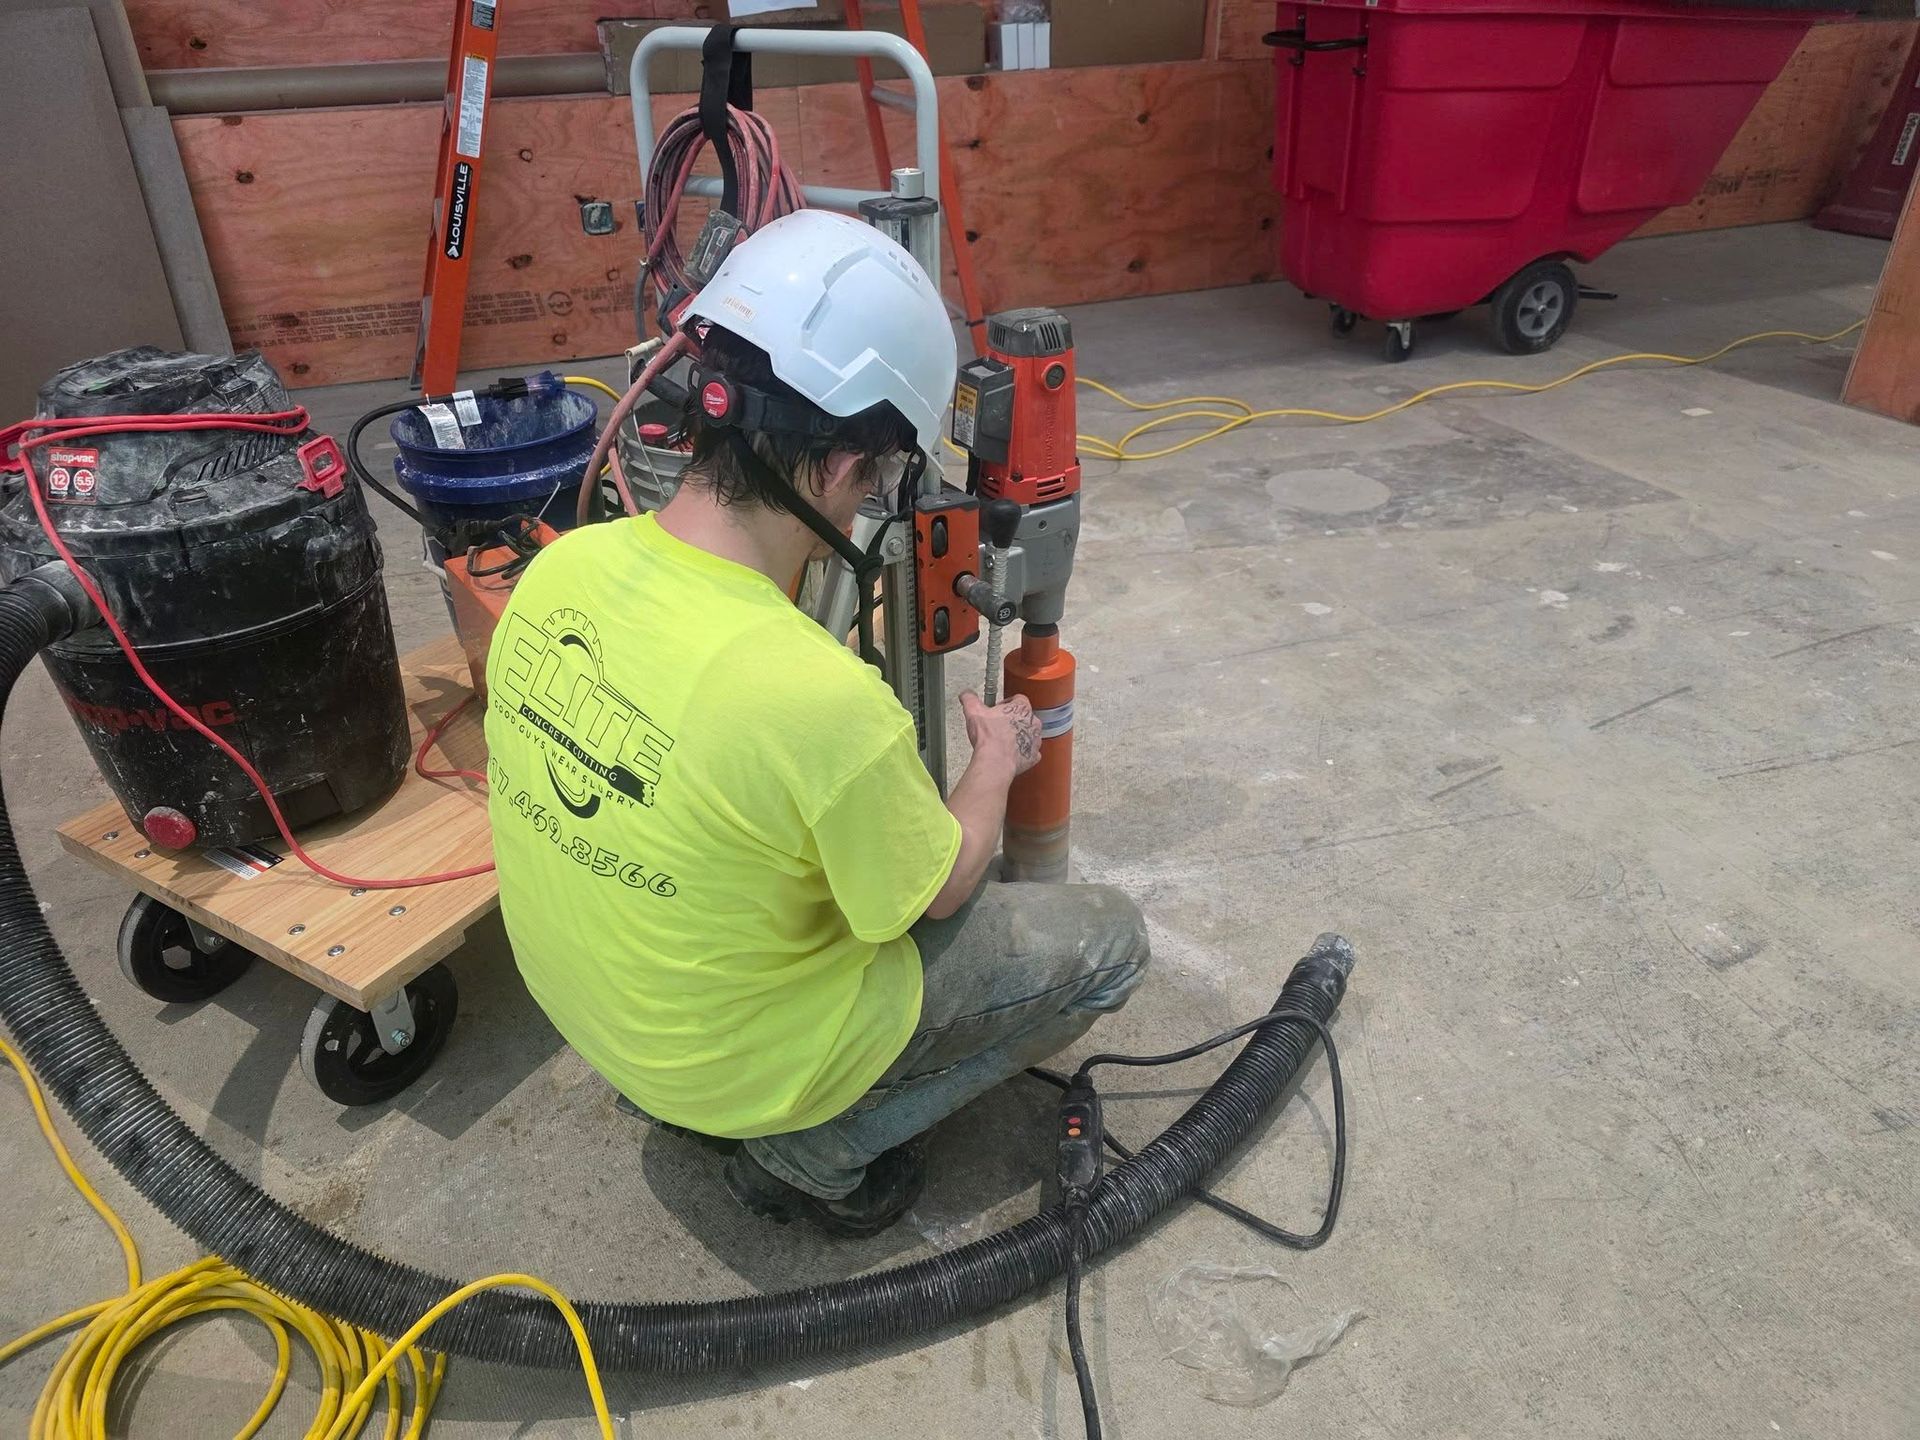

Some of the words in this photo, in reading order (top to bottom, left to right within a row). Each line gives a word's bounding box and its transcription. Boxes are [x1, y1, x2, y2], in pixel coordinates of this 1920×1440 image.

[452, 163, 468, 246] LOUISVILLE
[50, 452, 95, 464] shop-vac
[52, 474, 66, 486] 12
[76, 476, 92, 486] 5.5
[493, 612, 675, 785] ELITE
[494, 699, 516, 724] GOOD
[518, 724, 546, 750] GUYS
[551, 748, 578, 775] WEAR
[581, 774, 635, 809] SLURRY
[521, 706, 572, 749] CONCRETE
[572, 746, 618, 782] CUTTING
